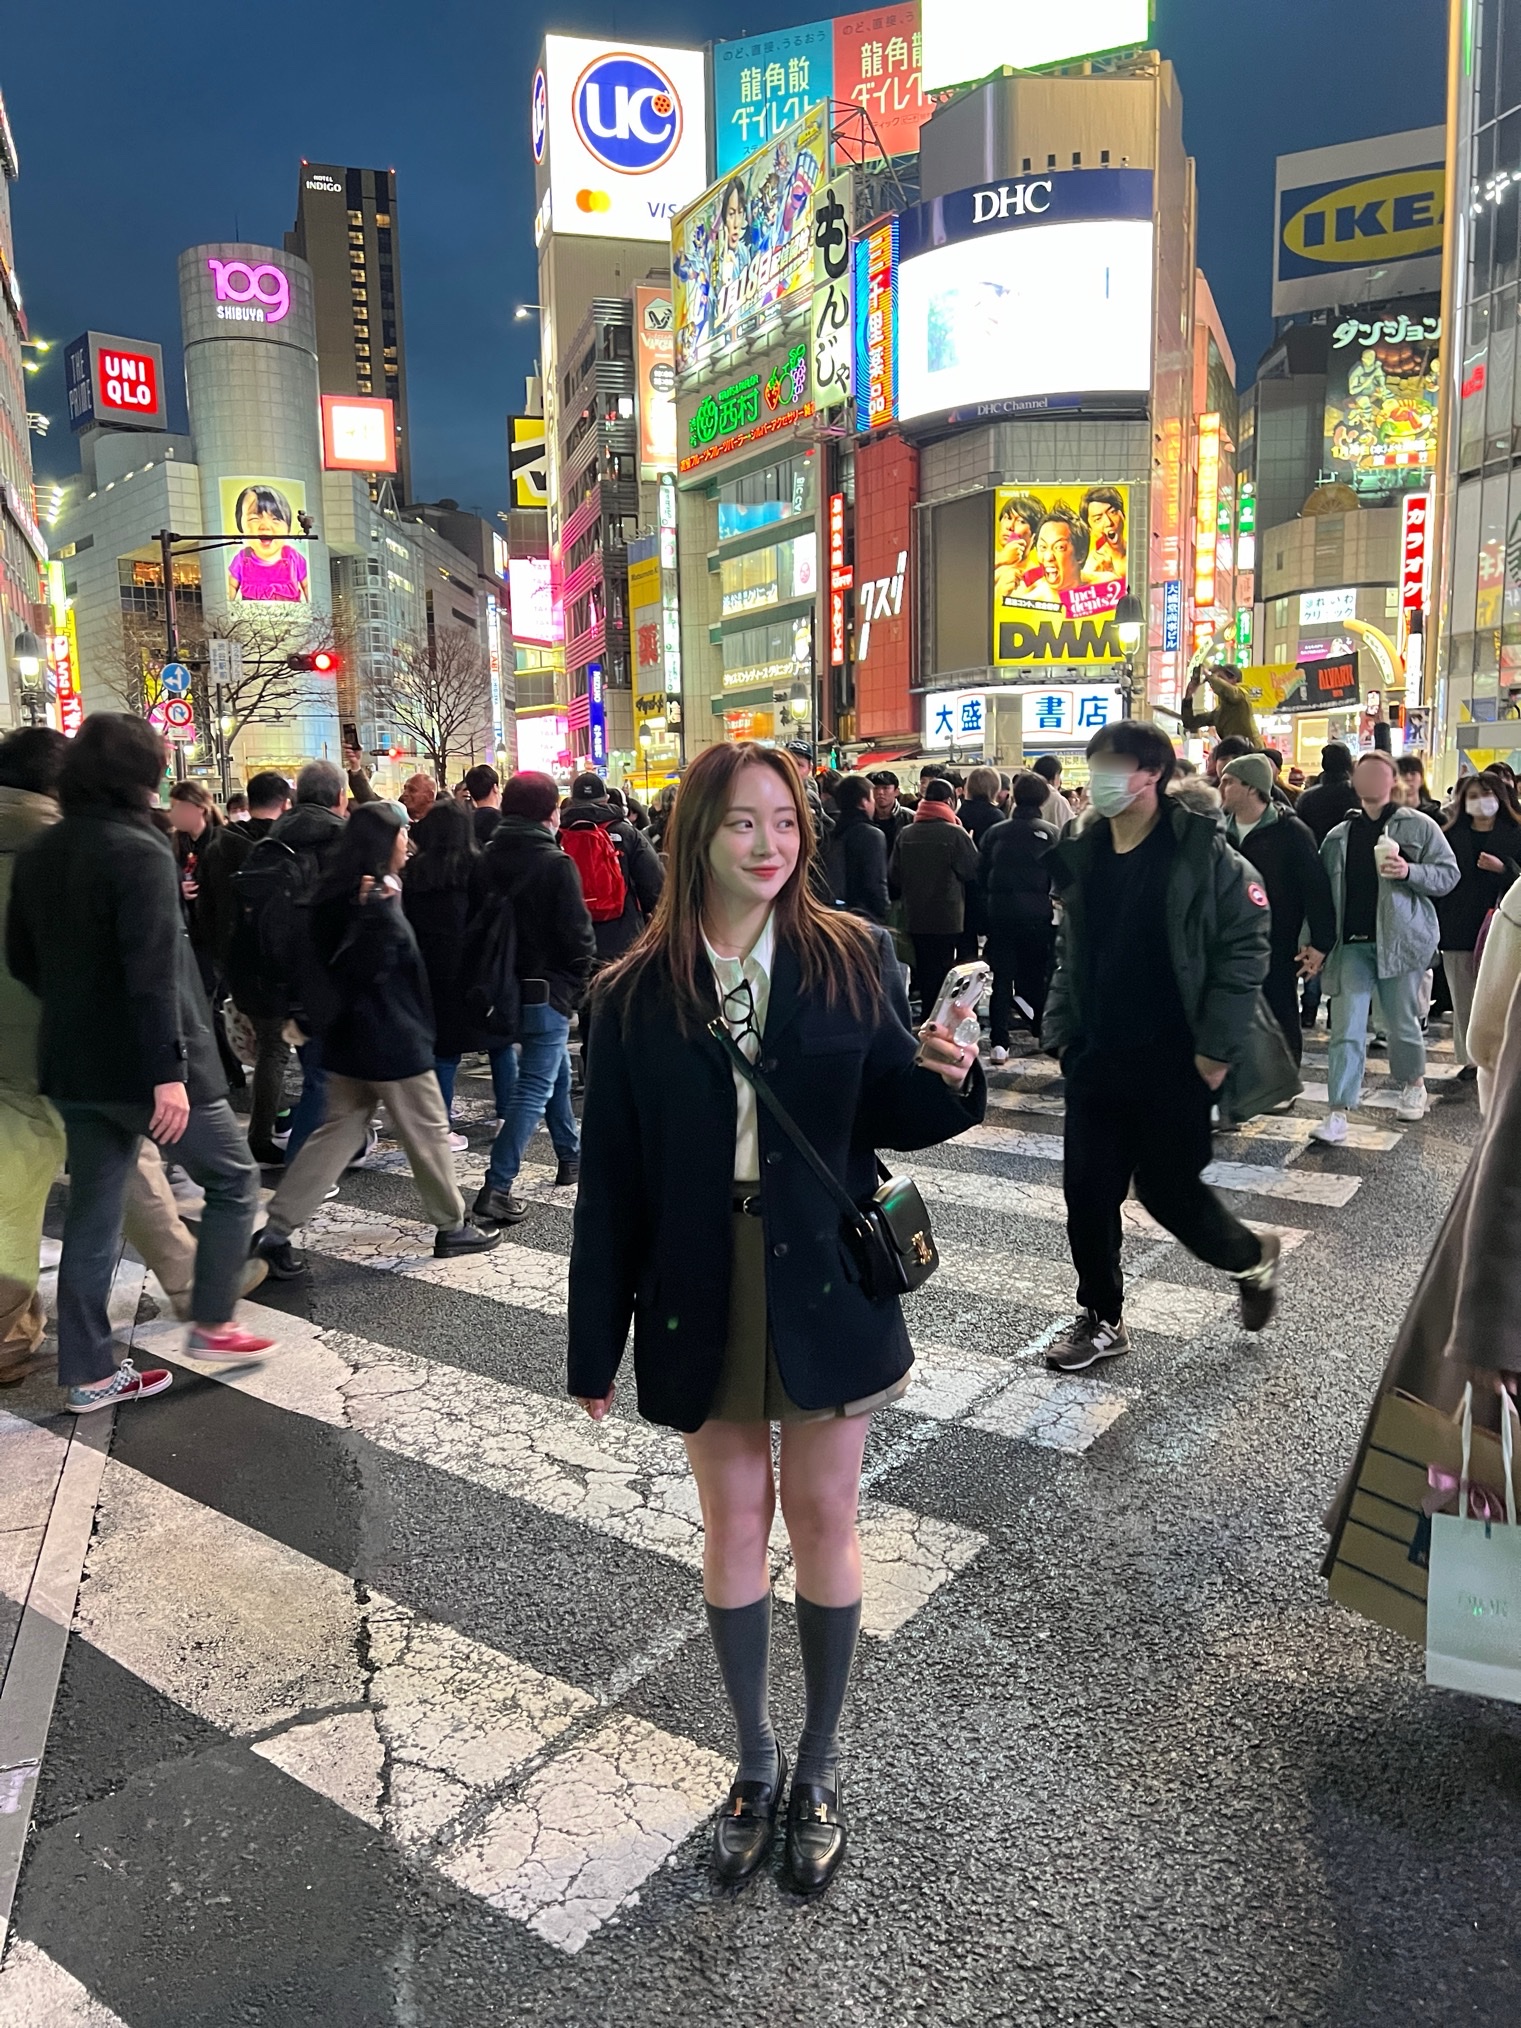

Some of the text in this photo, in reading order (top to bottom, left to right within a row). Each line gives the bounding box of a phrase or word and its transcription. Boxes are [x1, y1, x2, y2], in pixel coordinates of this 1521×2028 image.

[741, 55, 810, 104] 龍角散
[585, 82, 674, 144] UC
[306, 180, 342, 193] INDIGO
[973, 181, 1052, 223] DHC
[647, 202, 682, 218] VIS
[1303, 191, 1446, 248] IKE
[208, 259, 291, 323] 109
[815, 187, 850, 394] もんじゃ
[217, 305, 264, 322] SHIBUYA
[868, 236, 885, 415] 三千里薬品
[1333, 315, 1441, 349] ダンジョン
[70, 348, 85, 385] THE
[105, 355, 146, 382] UNI
[69, 378, 92, 420] PRIME
[107, 381, 151, 405] QLO
[719, 388, 760, 434] 西村
[977, 397, 1048, 417] DHC Channel
[795, 476, 805, 495] BIC
[1404, 508, 1427, 610] カラオケ
[1069, 586, 1096, 603] Inci
[1304, 608, 1354, 622] クリック
[1000, 620, 1125, 660] DMM
[935, 696, 1108, 734] 大盛 書店
